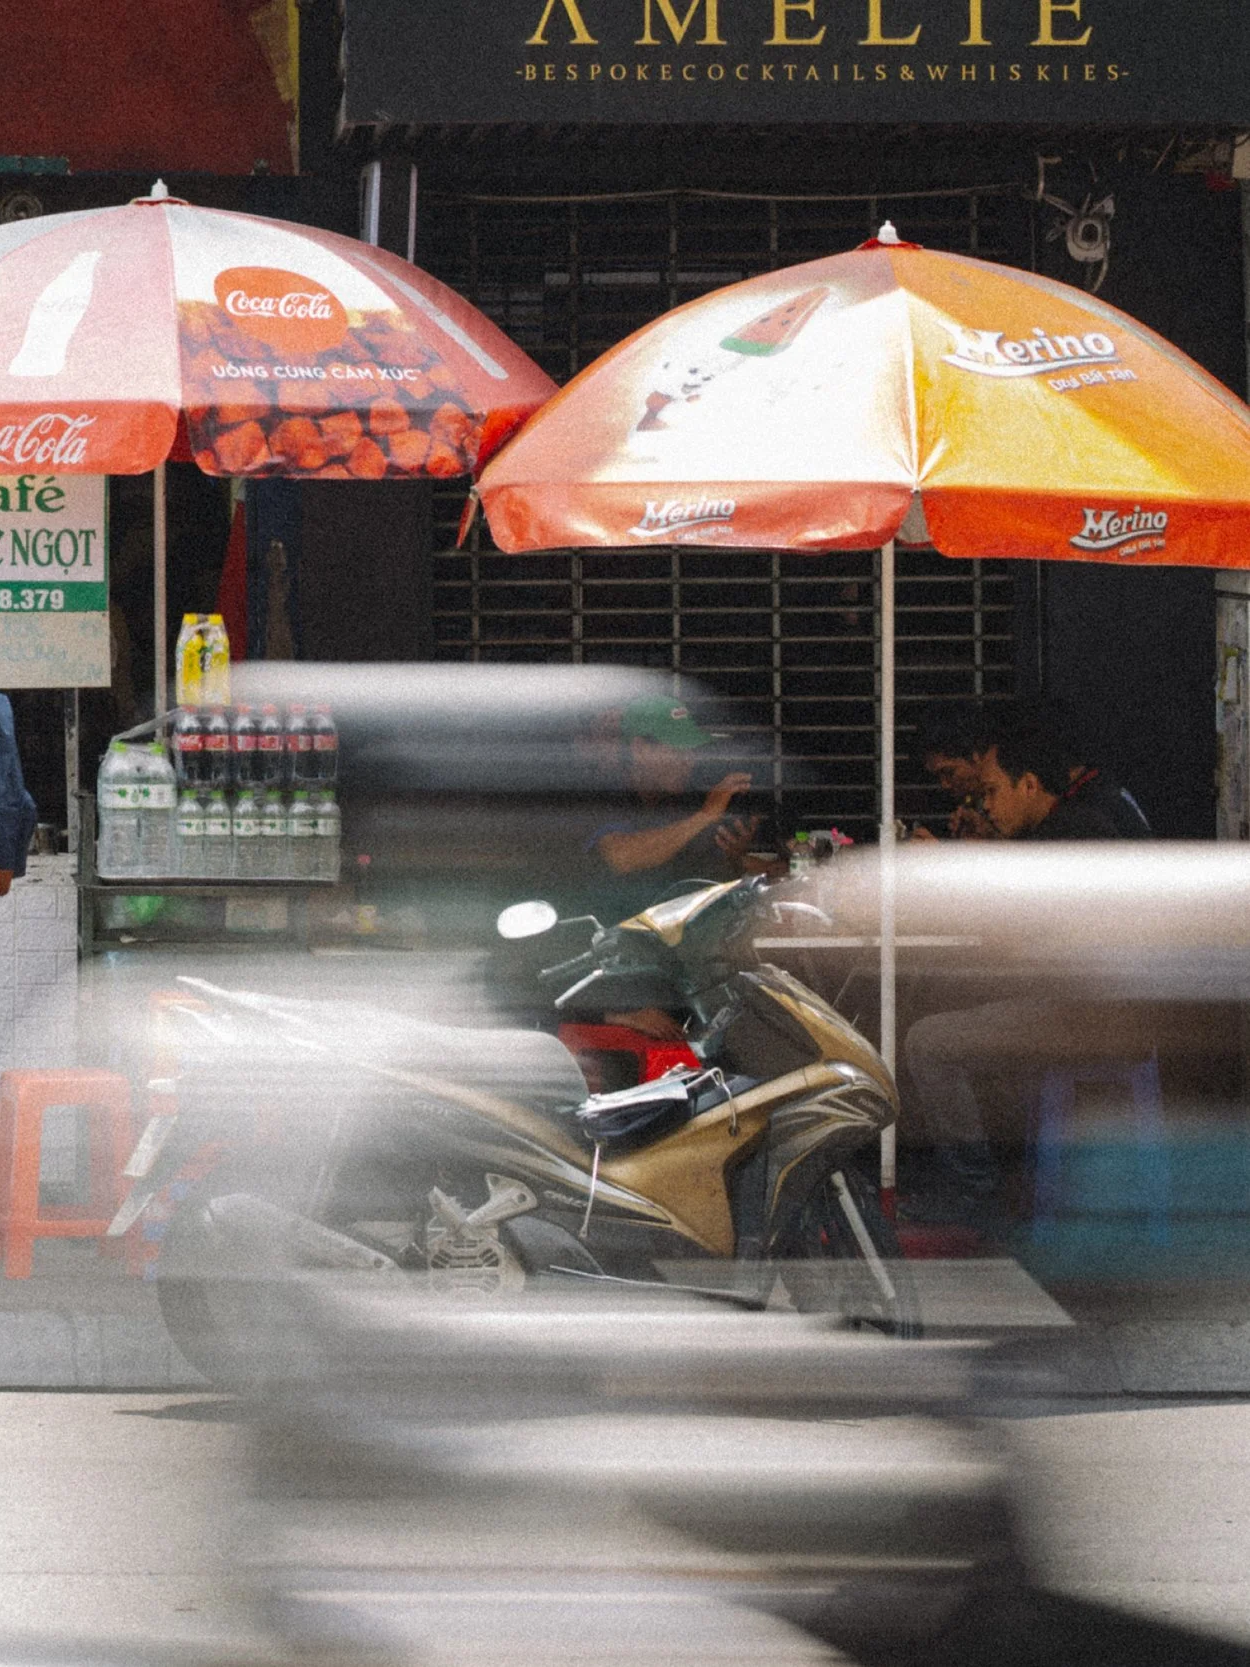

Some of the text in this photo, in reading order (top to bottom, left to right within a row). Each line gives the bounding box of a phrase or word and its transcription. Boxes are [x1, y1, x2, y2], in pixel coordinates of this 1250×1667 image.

[225, 289, 334, 319] Coca-Cola
[940, 326, 1117, 374] Merino
[632, 495, 738, 534] Merino
[1071, 504, 1169, 547] Merino
[10, 528, 97, 575] NGỌT
